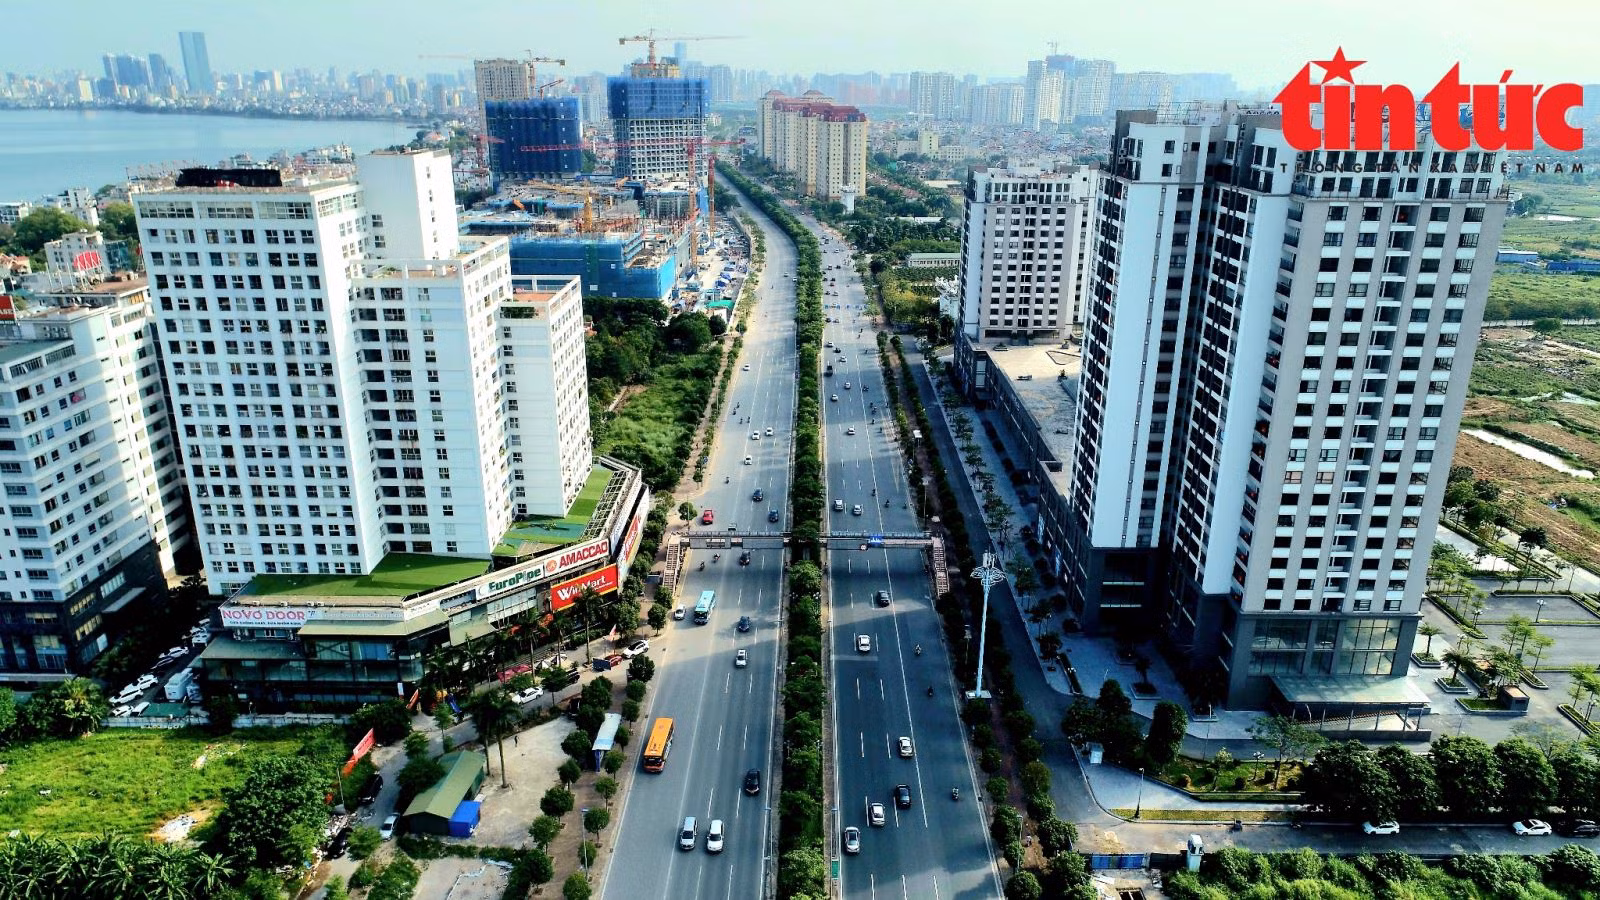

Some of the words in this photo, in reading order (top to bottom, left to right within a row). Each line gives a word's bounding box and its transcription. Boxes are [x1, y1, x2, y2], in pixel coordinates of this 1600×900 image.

[559, 541, 608, 568] AMACCAO
[488, 567, 541, 591] EuroPipe
[265, 611, 304, 620] DOOR
